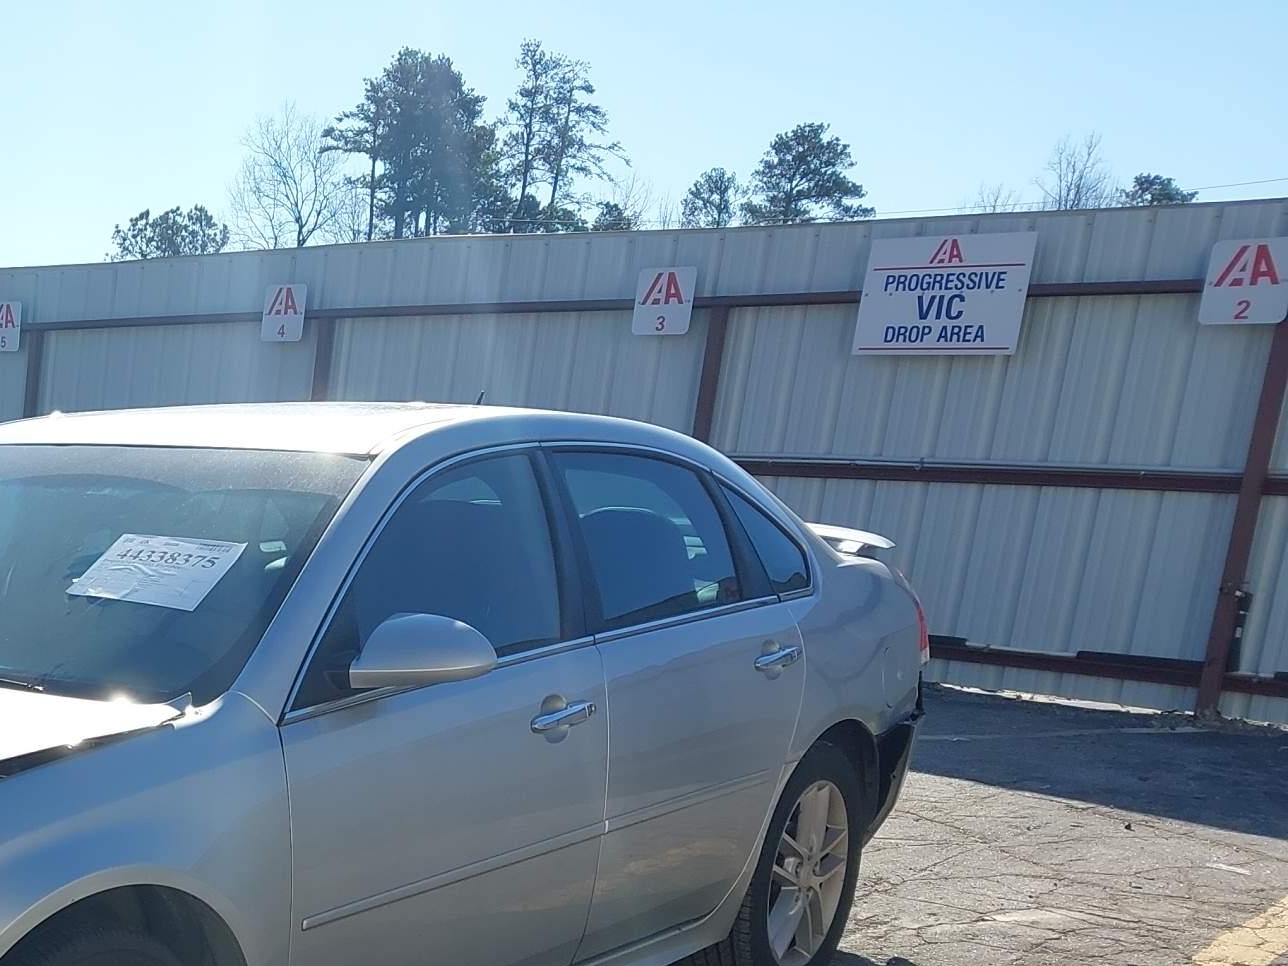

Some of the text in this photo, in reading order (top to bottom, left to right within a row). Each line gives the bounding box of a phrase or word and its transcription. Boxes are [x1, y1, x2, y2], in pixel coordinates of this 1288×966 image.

[883, 270, 1008, 292] PROGRESSIVE
[917, 293, 966, 321] VIC
[1233, 299, 1251, 320] 2
[277, 324, 286, 338] 4
[655, 315, 666, 332] 3
[883, 324, 985, 343] DROP AREA
[0, 336, 7, 348] 5
[116, 548, 221, 569] 44338375
